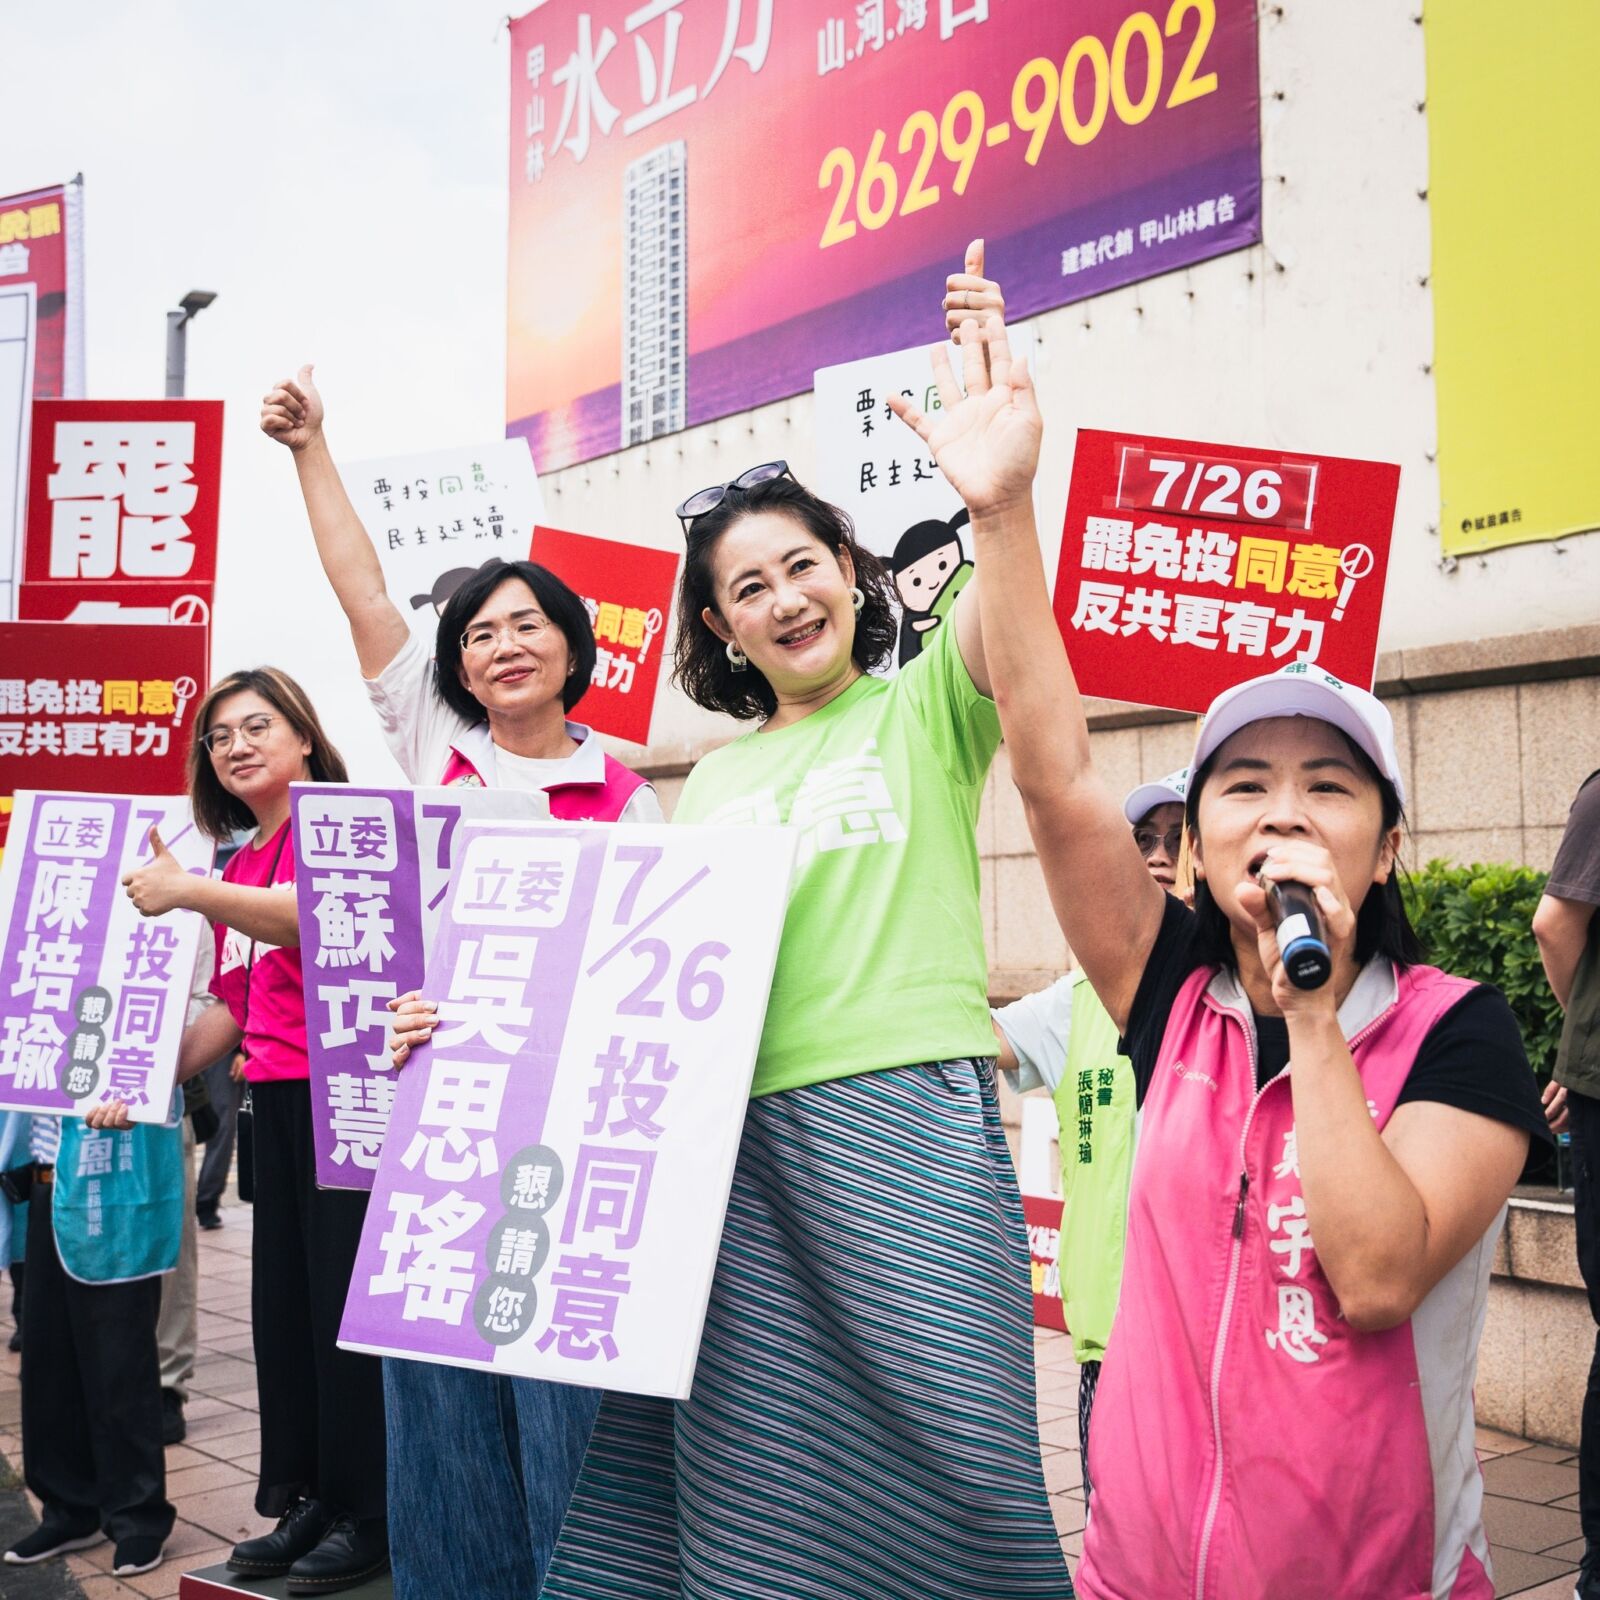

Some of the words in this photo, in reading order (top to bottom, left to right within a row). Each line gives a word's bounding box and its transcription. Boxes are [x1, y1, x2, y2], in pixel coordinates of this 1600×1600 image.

[526, 44, 545, 183] 甲山林
[819, 0, 1218, 249] 2629-9002
[1139, 193, 1236, 248] 甲山林廣告
[48, 421, 198, 625] 罷
[1149, 459, 1283, 519] 7/26
[1071, 581, 1325, 663] 反共更有力
[0, 722, 170, 757] 反共更有力
[42, 815, 105, 849] 立委
[310, 814, 388, 860] 立委
[463, 859, 565, 914] 立委
[0, 859, 98, 1091] 陳培瑜
[586, 845, 733, 1022] 7/26
[68, 996, 106, 1094] 懇請您
[100, 922, 179, 1107] 投同意
[312, 872, 397, 1170] 蘇巧慧
[368, 934, 540, 1326] 吳思瑤
[1097, 1068, 1114, 1106] 秘書
[489, 1163, 553, 1333] 懇請您
[535, 1035, 680, 1363] 投同意
